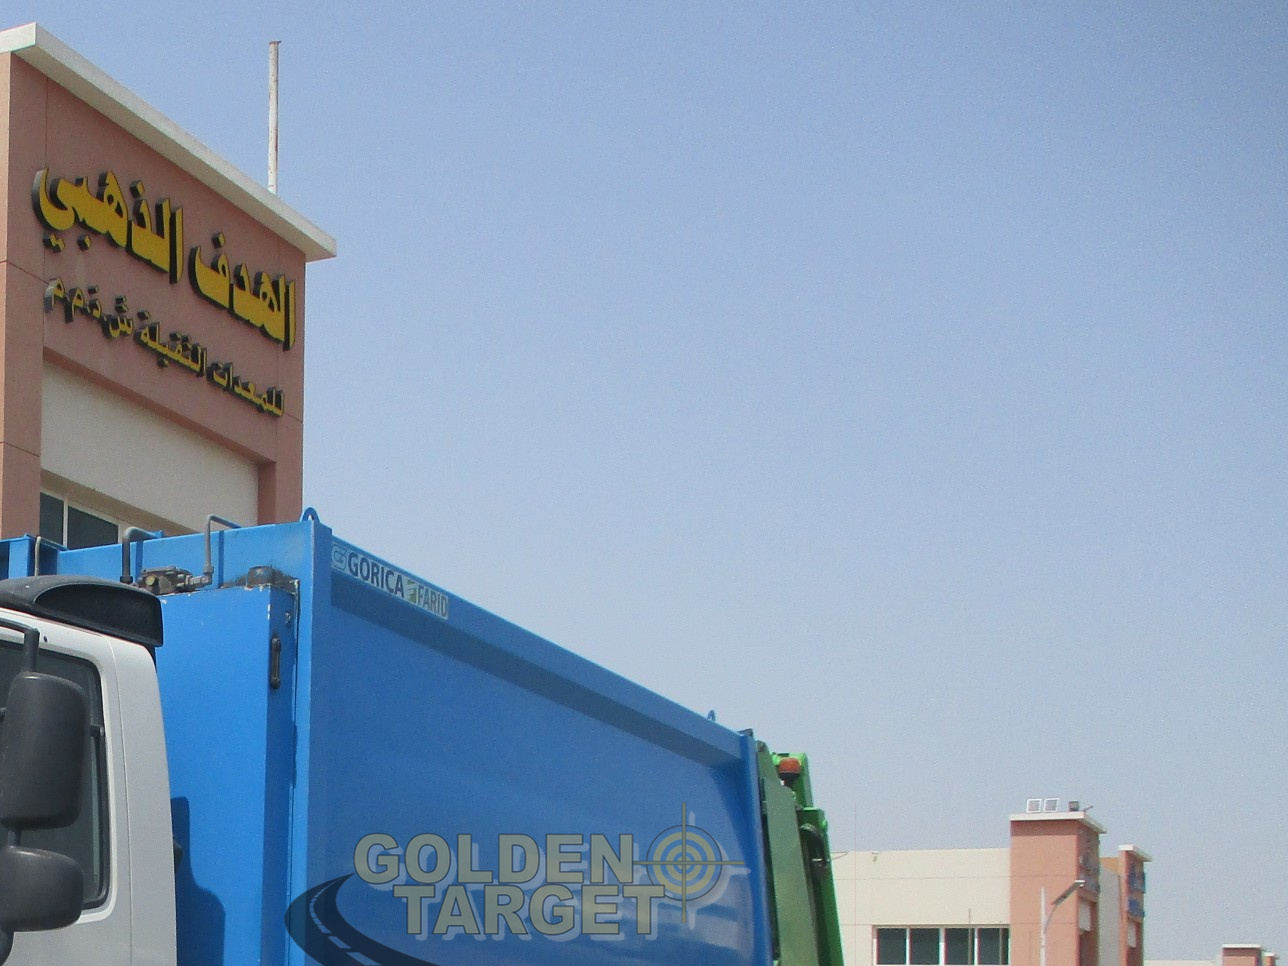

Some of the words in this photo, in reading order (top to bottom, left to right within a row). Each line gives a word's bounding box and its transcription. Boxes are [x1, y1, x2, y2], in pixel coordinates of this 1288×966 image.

[31, 167, 184, 284] الذهبي
[188, 232, 296, 351] الهدف
[133, 310, 208, 378] الثقيلة
[207, 361, 285, 417] للمعدات
[348, 551, 405, 598] GORICA
[416, 583, 449, 618] FARID
